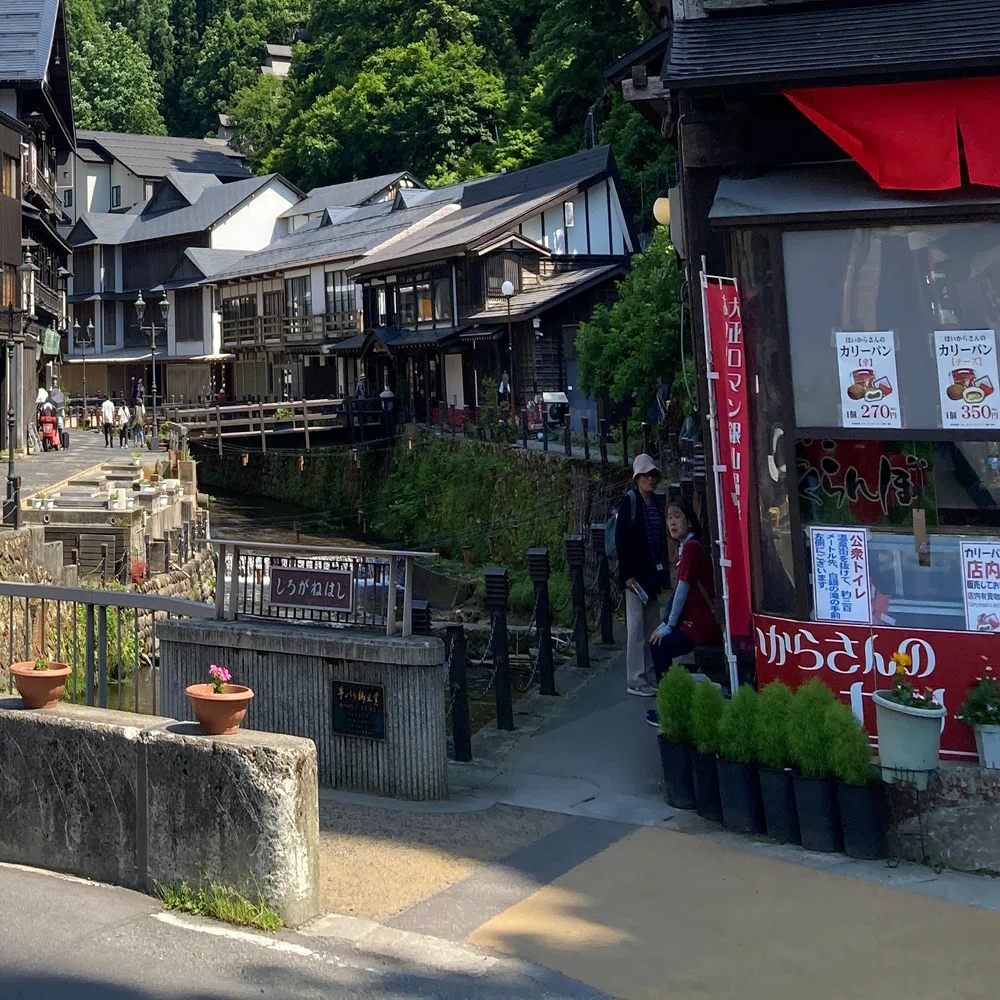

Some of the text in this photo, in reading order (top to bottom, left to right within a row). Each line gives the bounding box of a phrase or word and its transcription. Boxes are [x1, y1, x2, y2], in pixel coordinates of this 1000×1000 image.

[845, 336, 886, 344] はいからさんの
[840, 345, 893, 357] カリーパン
[939, 344, 993, 357] カリーパン
[850, 534, 866, 599] 公衆トイレ
[276, 577, 346, 600] しろがねはし
